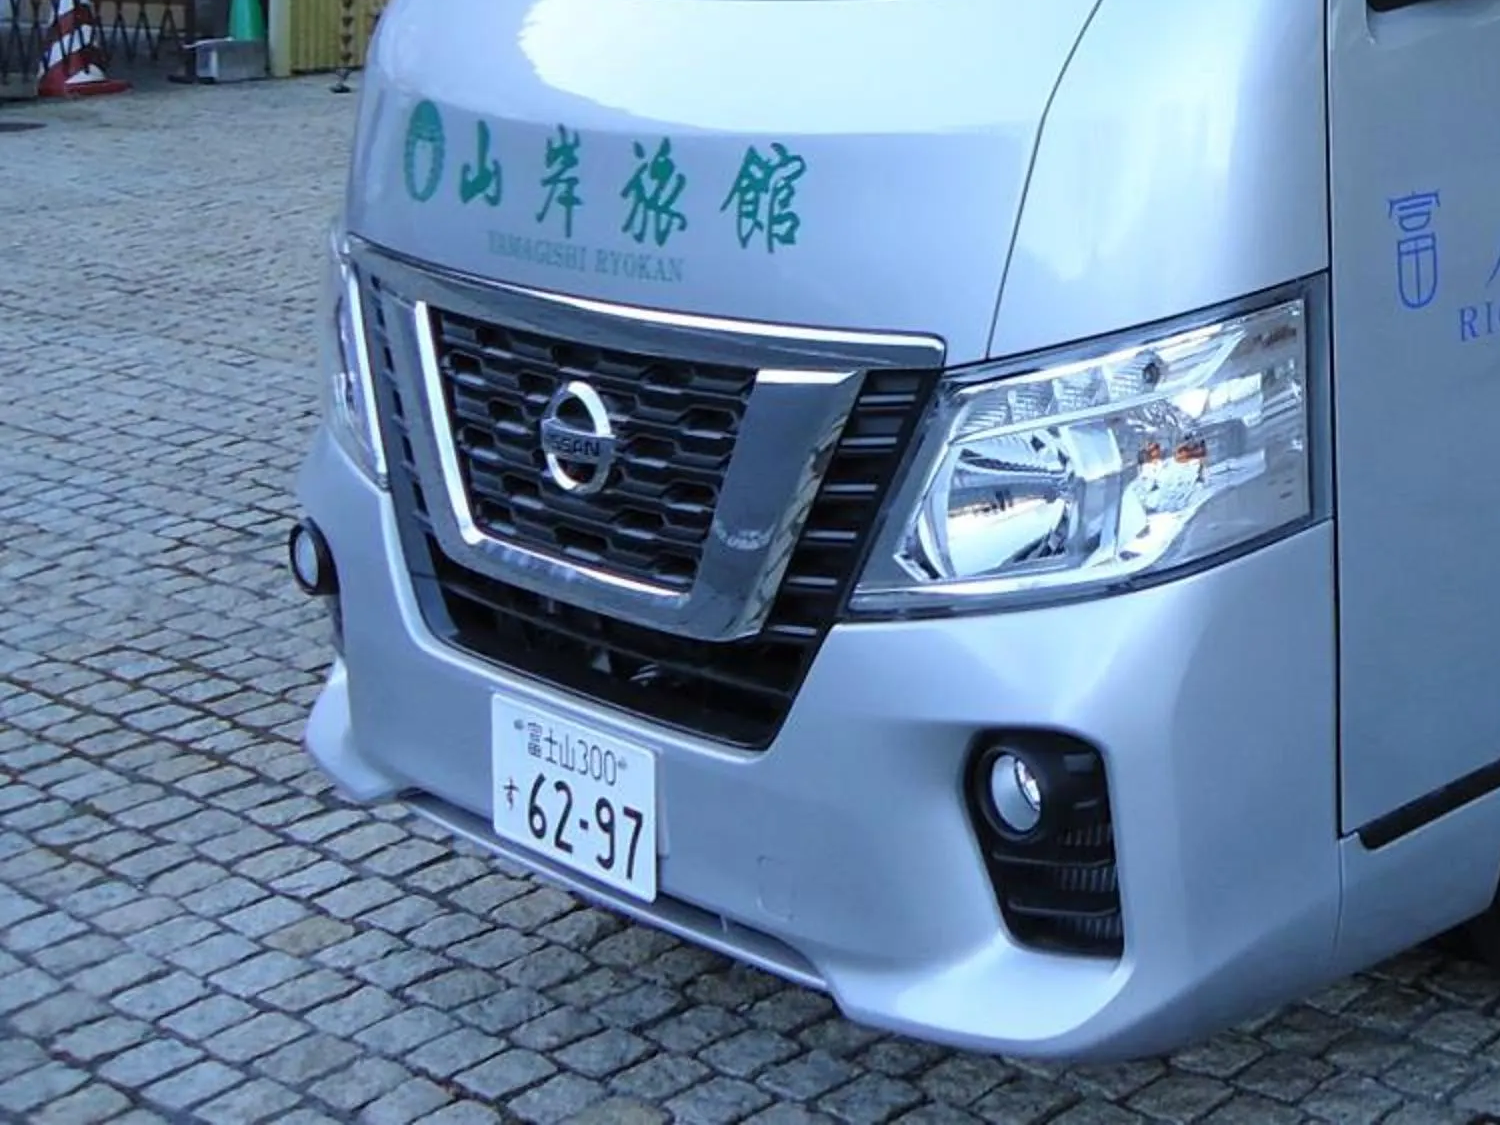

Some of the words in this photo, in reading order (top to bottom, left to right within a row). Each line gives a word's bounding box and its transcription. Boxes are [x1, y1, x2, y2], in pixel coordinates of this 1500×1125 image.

[459, 119, 807, 253] 山岸旅館
[487, 230, 587, 273] YAMAGISHI
[595, 248, 685, 283] RYOKAN
[527, 772, 643, 880] 62-97
